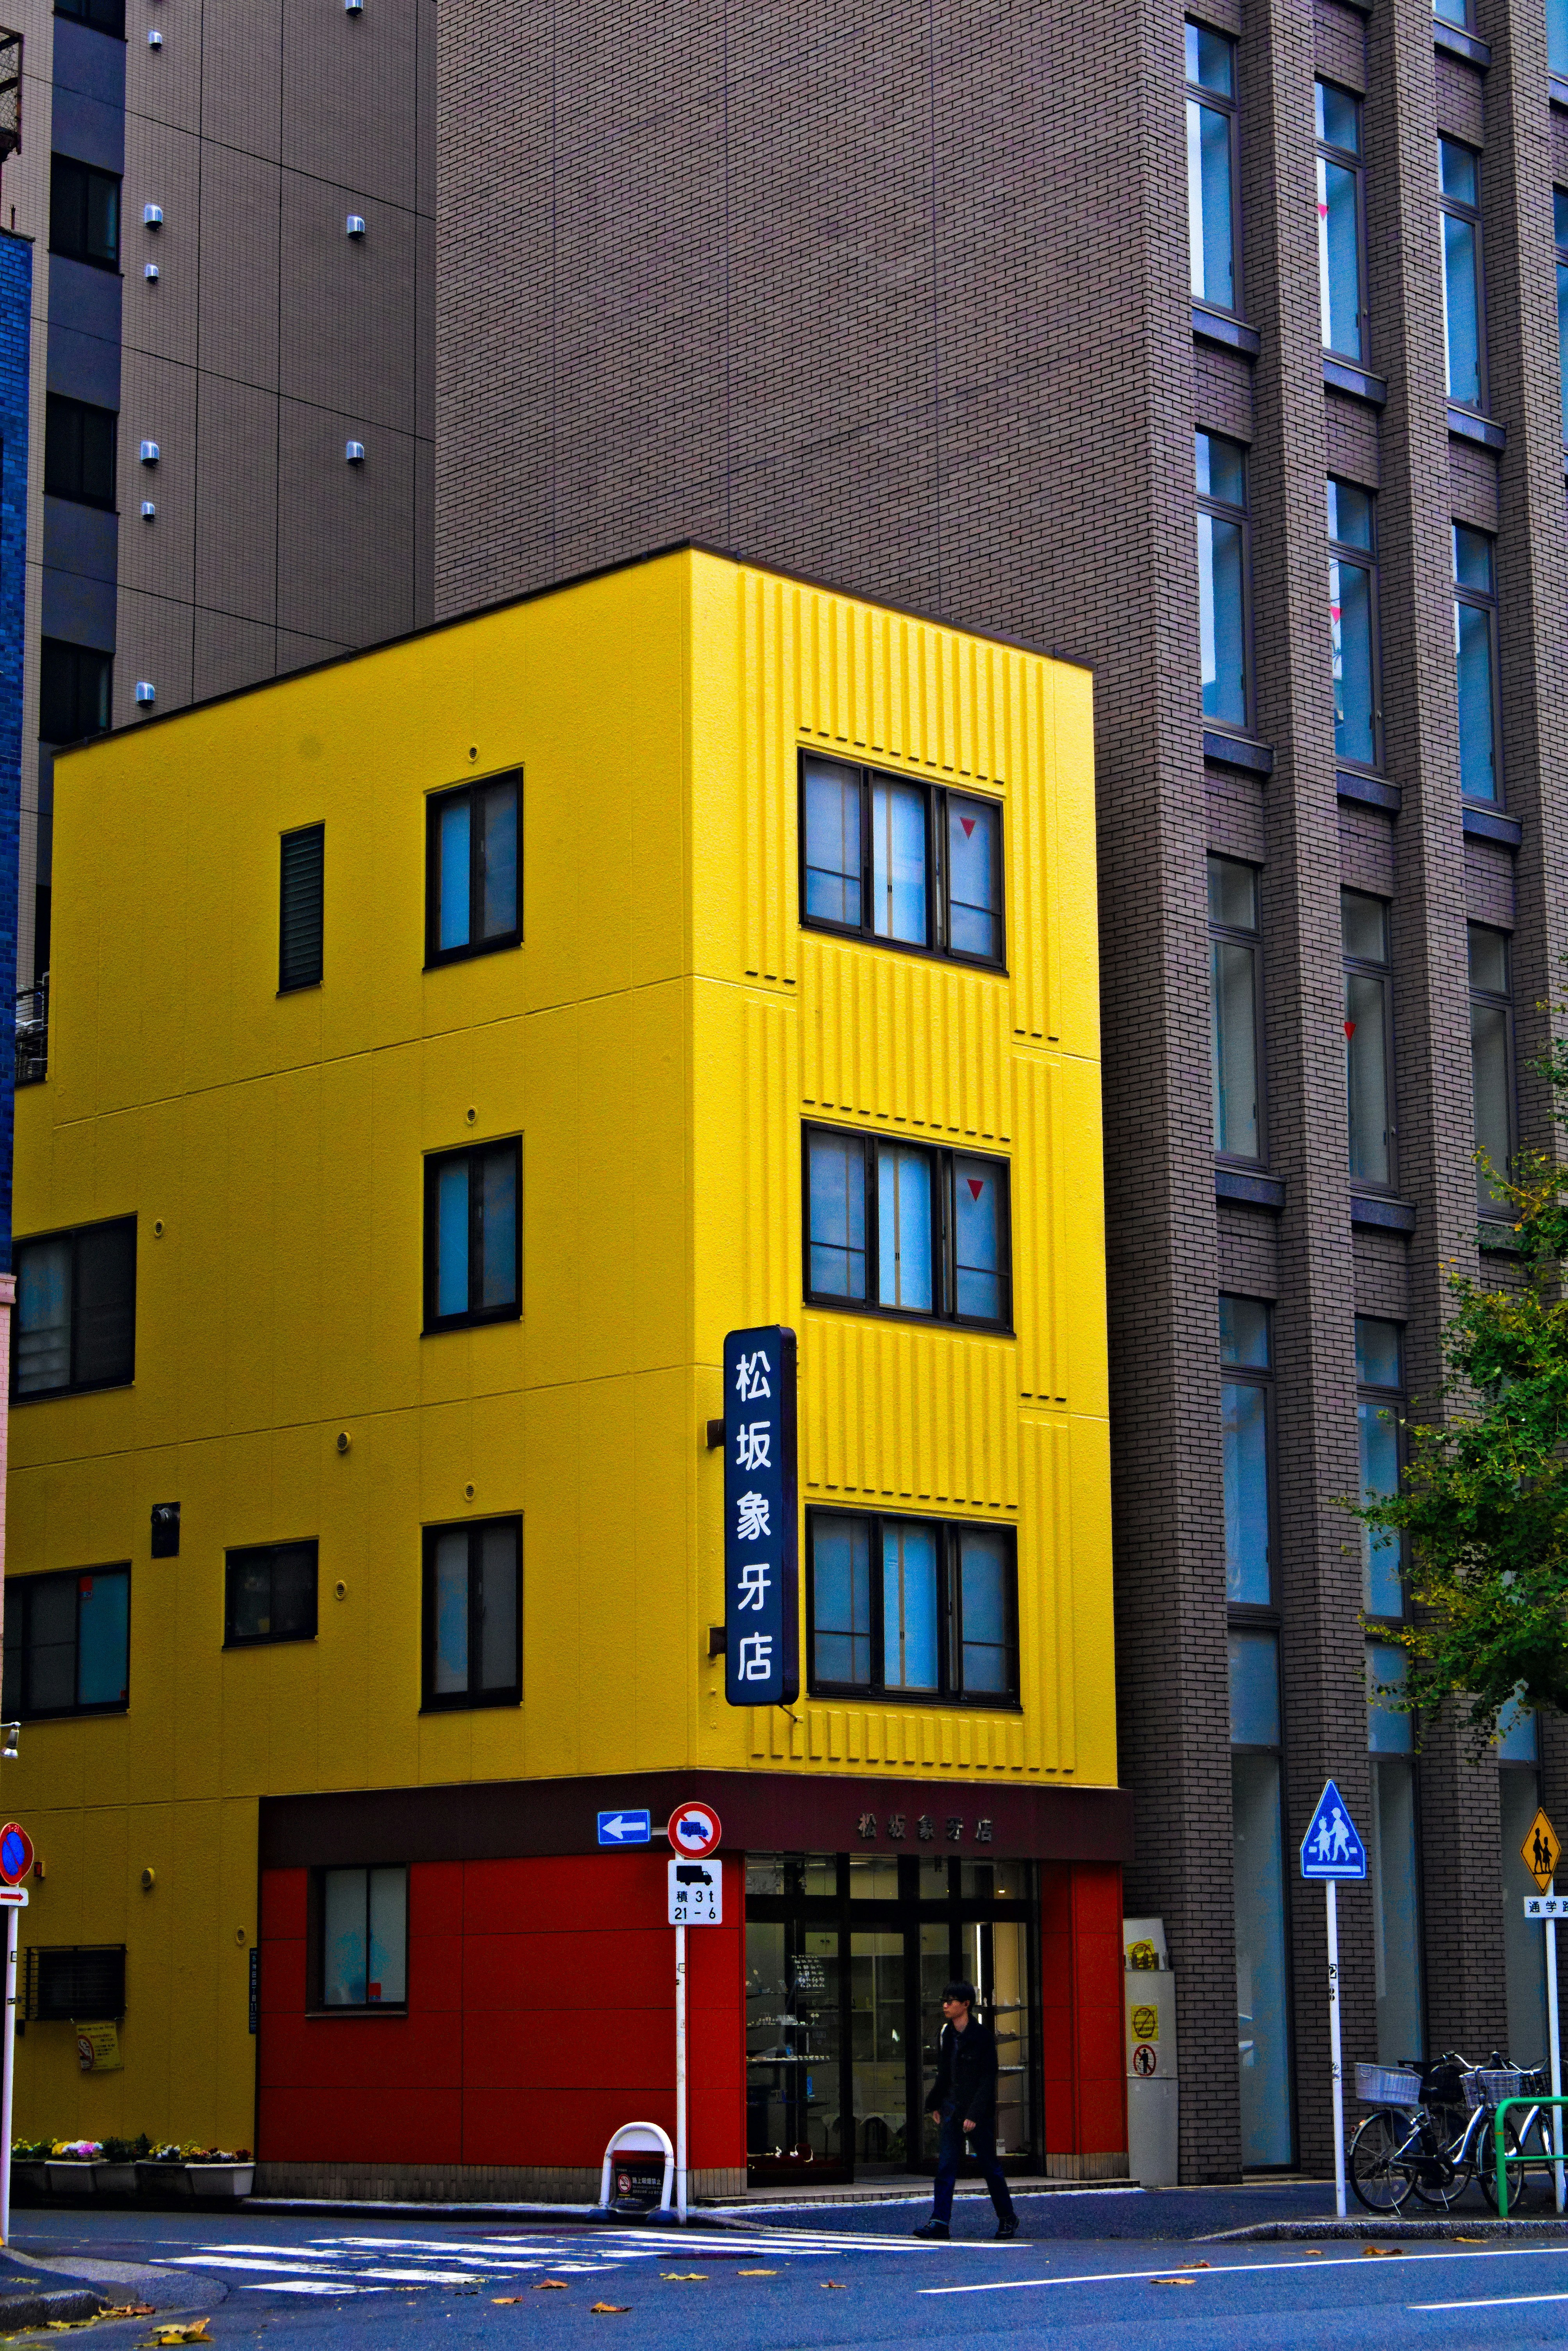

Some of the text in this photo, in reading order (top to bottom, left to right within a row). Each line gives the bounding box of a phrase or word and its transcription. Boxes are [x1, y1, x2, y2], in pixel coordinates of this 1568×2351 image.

[736, 1350, 773, 1681] 松坂象牙店
[858, 1812, 993, 1841] 松坂象牙店
[677, 1891, 688, 1902] 積
